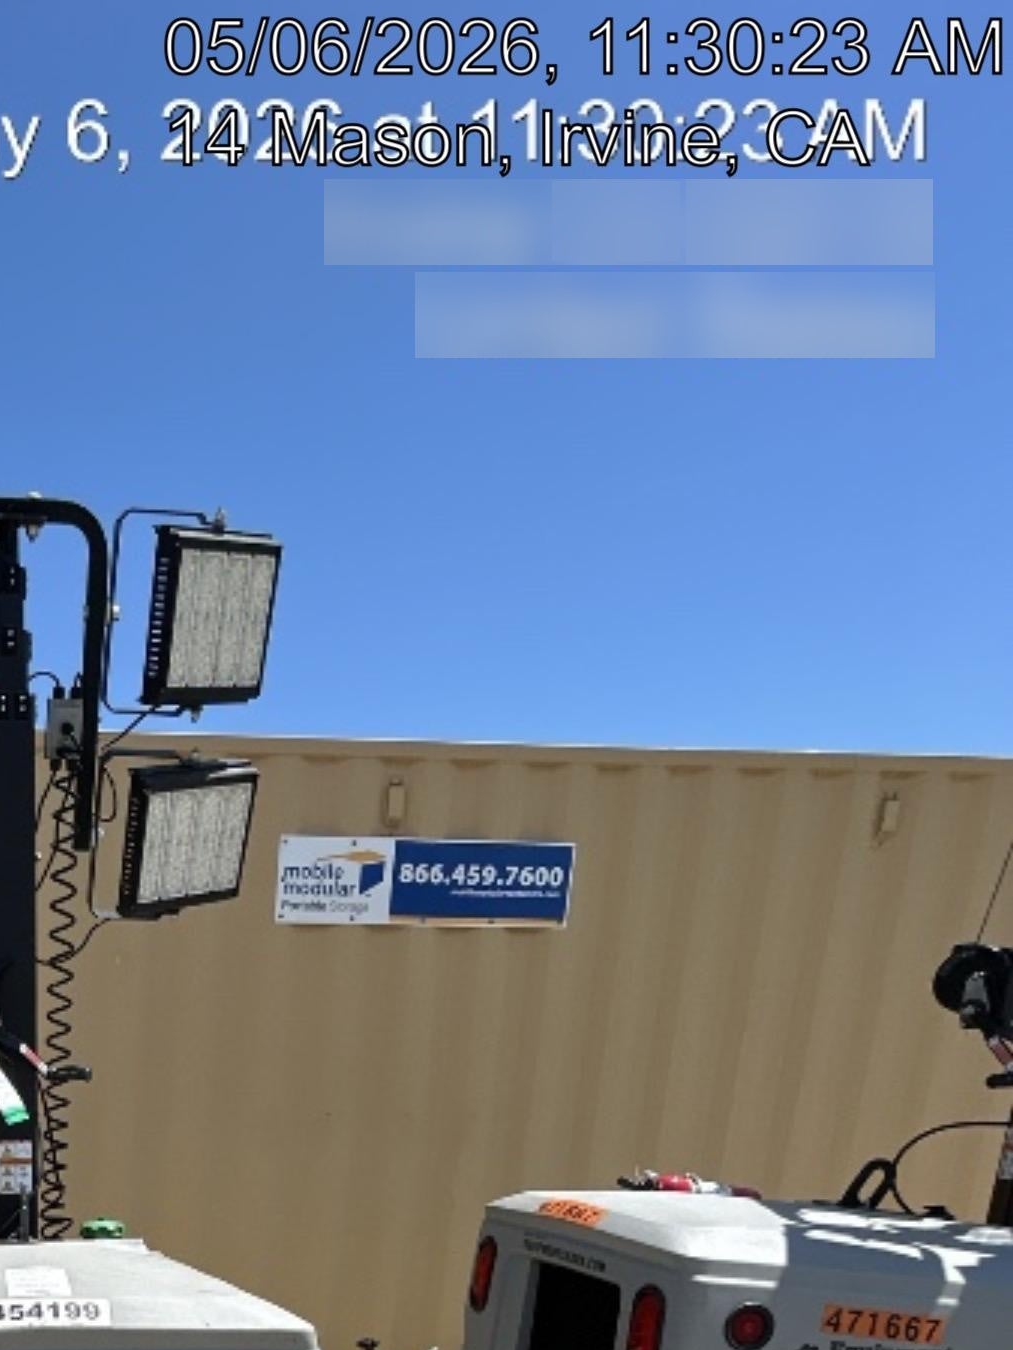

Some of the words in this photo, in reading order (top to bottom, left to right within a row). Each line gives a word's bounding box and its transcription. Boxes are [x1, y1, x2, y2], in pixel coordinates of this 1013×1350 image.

[281, 863, 345, 881] mobile
[398, 863, 564, 886] 866.459.7600
[283, 881, 357, 897] modular
[825, 1307, 942, 1343] 471667
